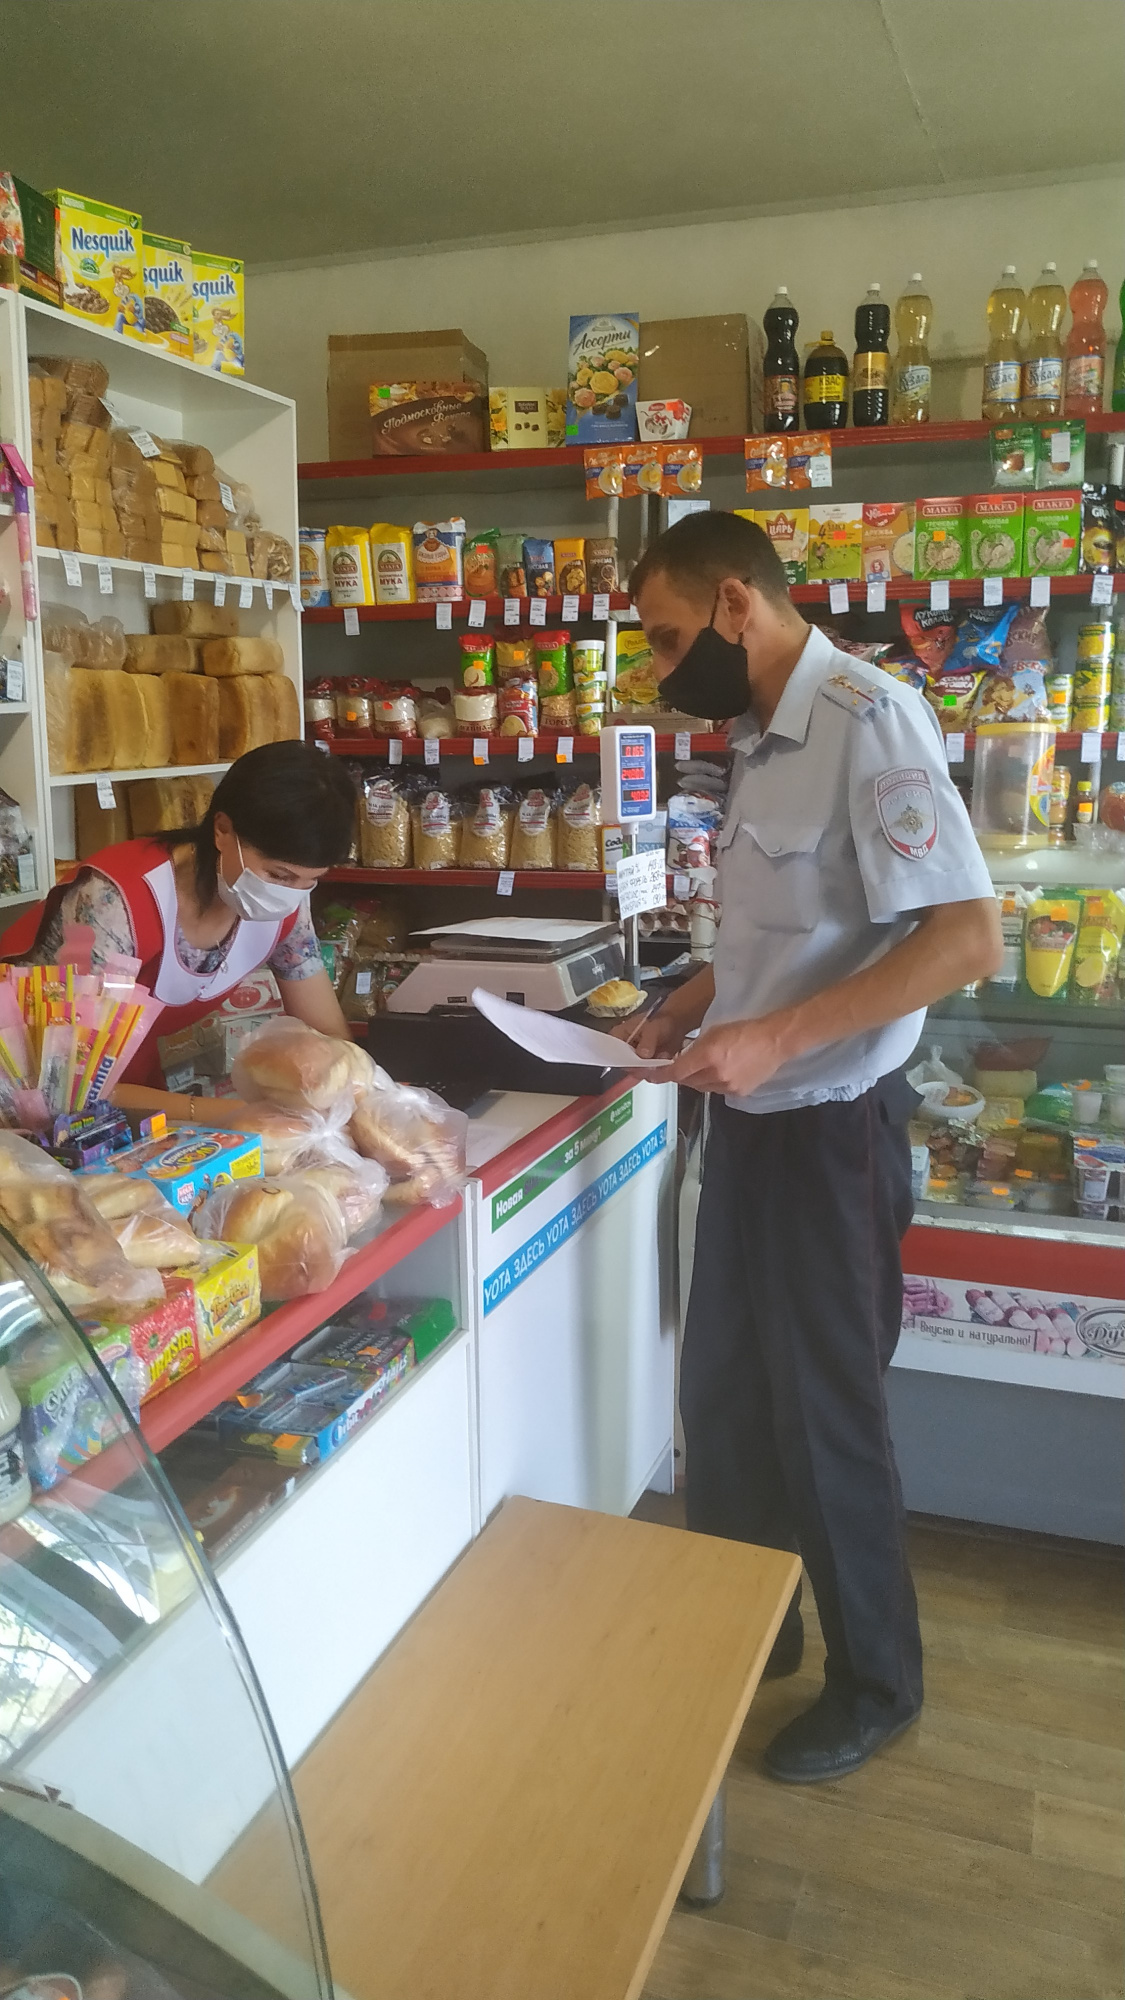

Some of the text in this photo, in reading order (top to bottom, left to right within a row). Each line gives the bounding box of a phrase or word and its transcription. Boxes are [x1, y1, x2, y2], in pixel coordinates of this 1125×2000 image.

[71, 227, 135, 259] Nesquik
[143, 261, 185, 290] squik
[192, 274, 237, 302] squik
[573, 330, 631, 355] Ассорти
[819, 376, 841, 387] КВАС
[382, 400, 462, 435] Подмосковные
[979, 502, 1013, 512] MAKFA
[769, 524, 794, 535] ЦАРЬ
[874, 561, 880, 569] 5
[909, 843, 928, 858] МВД
[496, 1188, 523, 1219] Новая
[564, 1147, 574, 1163] за
[574, 1141, 580, 1155] 5
[484, 1268, 511, 1306] YOTA
[513, 1241, 545, 1279] ЗДЕСЬ
[546, 1215, 569, 1245] YOTA
[571, 1194, 597, 1225] ЗДЕСЬ
[598, 1173, 618, 1199] YOTA
[618, 1153, 641, 1181] ЗДЕСЬ
[641, 1135, 658, 1156] YOTA
[919, 1320, 1031, 1346] Вкусно и натурально!
[382, 1353, 408, 1388] HALLS
